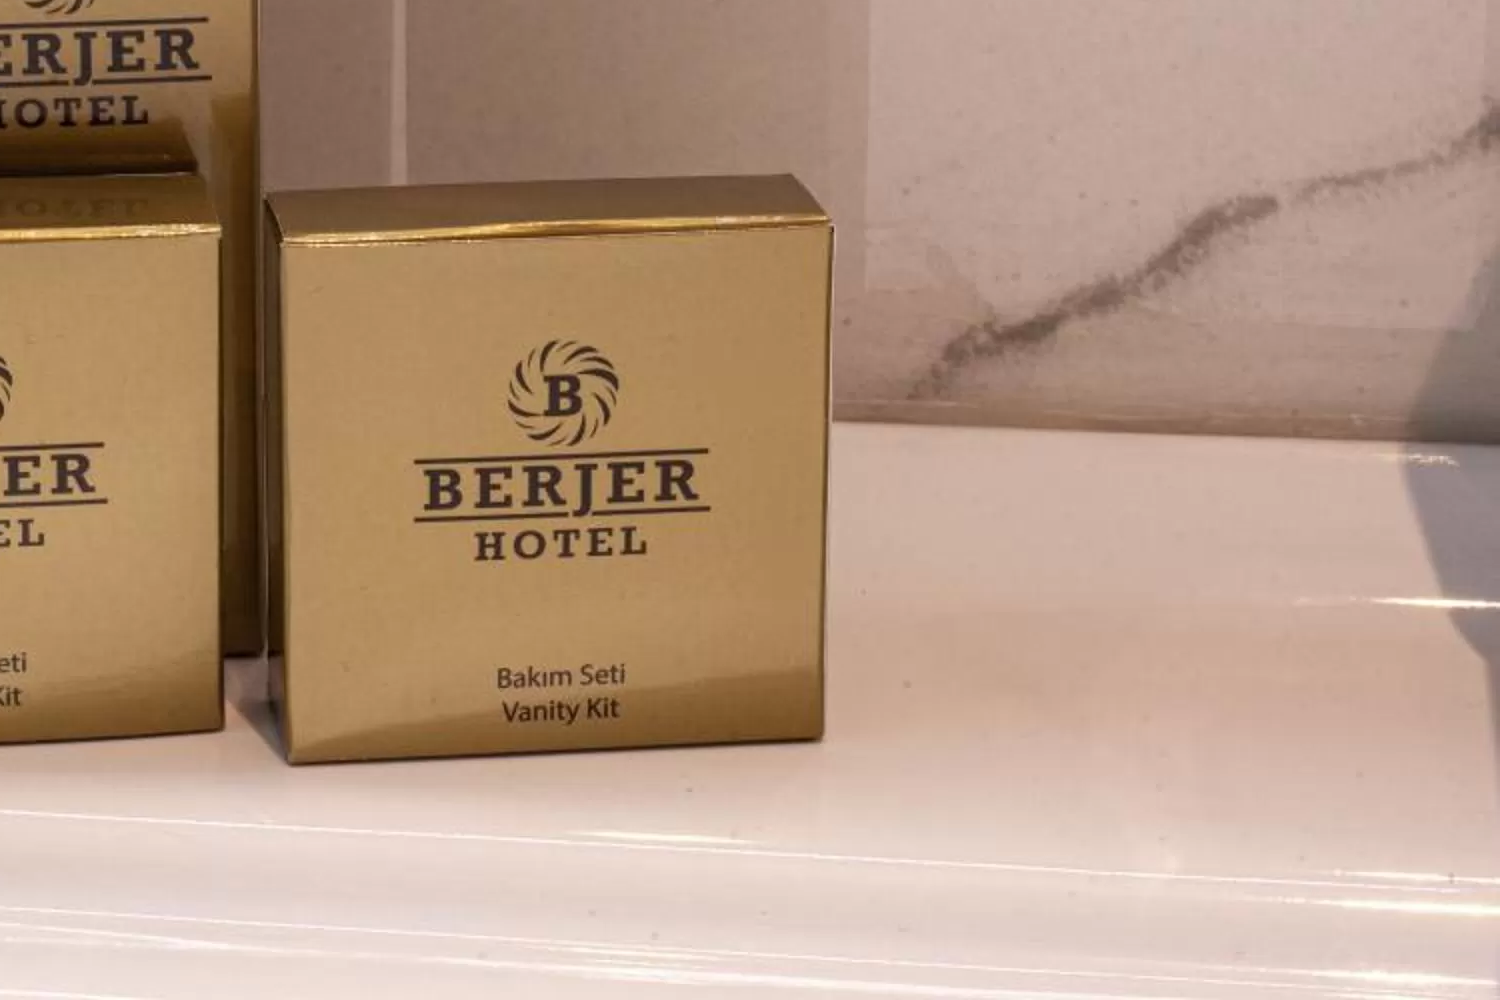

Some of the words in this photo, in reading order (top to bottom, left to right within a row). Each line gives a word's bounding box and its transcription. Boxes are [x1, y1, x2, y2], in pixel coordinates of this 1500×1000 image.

[543, 374, 583, 417] B
[423, 459, 700, 517] BERJER
[474, 526, 647, 562] HOTEL
[497, 665, 573, 690] Bakım
[579, 663, 626, 686] Seti
[501, 699, 581, 726] Vanity
[586, 697, 620, 719] Kit
